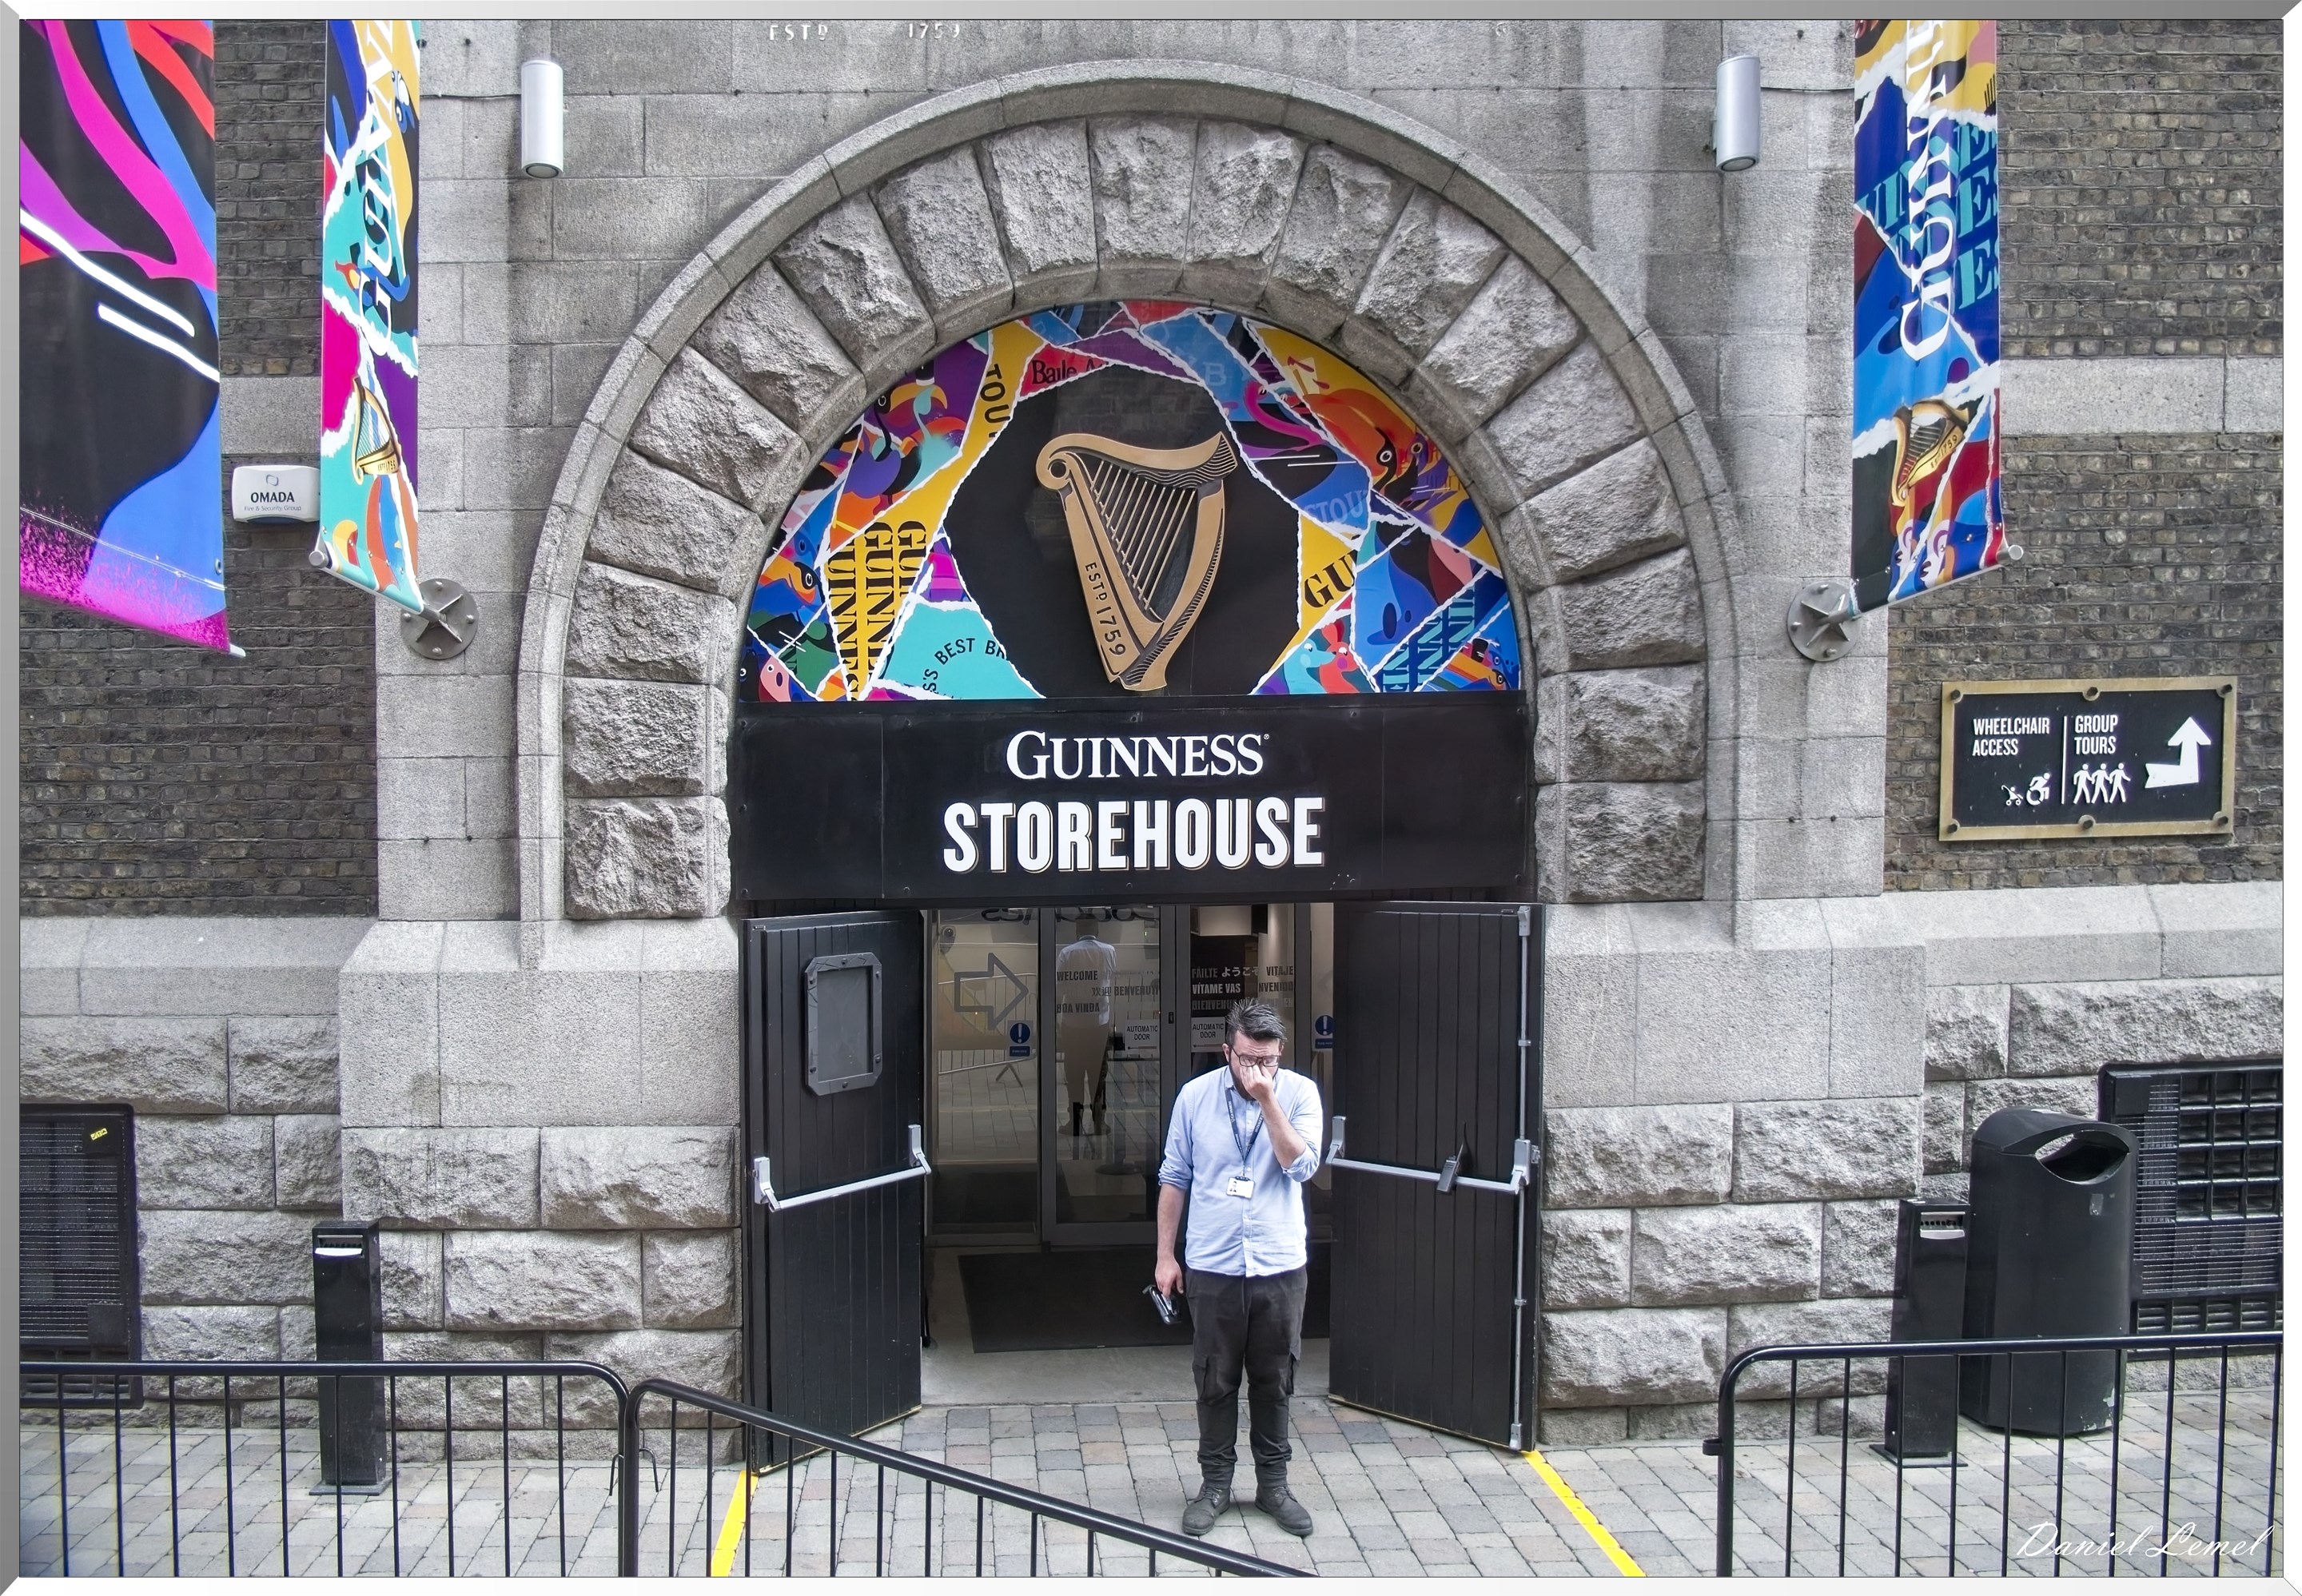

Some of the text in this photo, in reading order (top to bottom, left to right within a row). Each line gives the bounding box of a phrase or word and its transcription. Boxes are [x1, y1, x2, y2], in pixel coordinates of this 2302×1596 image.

[908, 23, 960, 39] 1759
[980, 364, 1011, 438] TOU
[250, 492, 295, 503] OMADA
[864, 522, 895, 680] GUINNE
[1096, 606, 1126, 656] 1759
[934, 638, 975, 665] BEST
[1973, 717, 2050, 735] WHEELCHAIR
[2074, 714, 2118, 734] GROUP
[1006, 730, 1265, 780] GUINNESS
[1972, 738, 2019, 757] ACCESS
[2074, 737, 2117, 754] TOURS
[943, 797, 1325, 874] STOREHOUSE
[1056, 970, 1098, 981] WELCOME
[1258, 981, 1294, 993] NVENIDO
[1056, 1003, 1073, 1013] BOA
